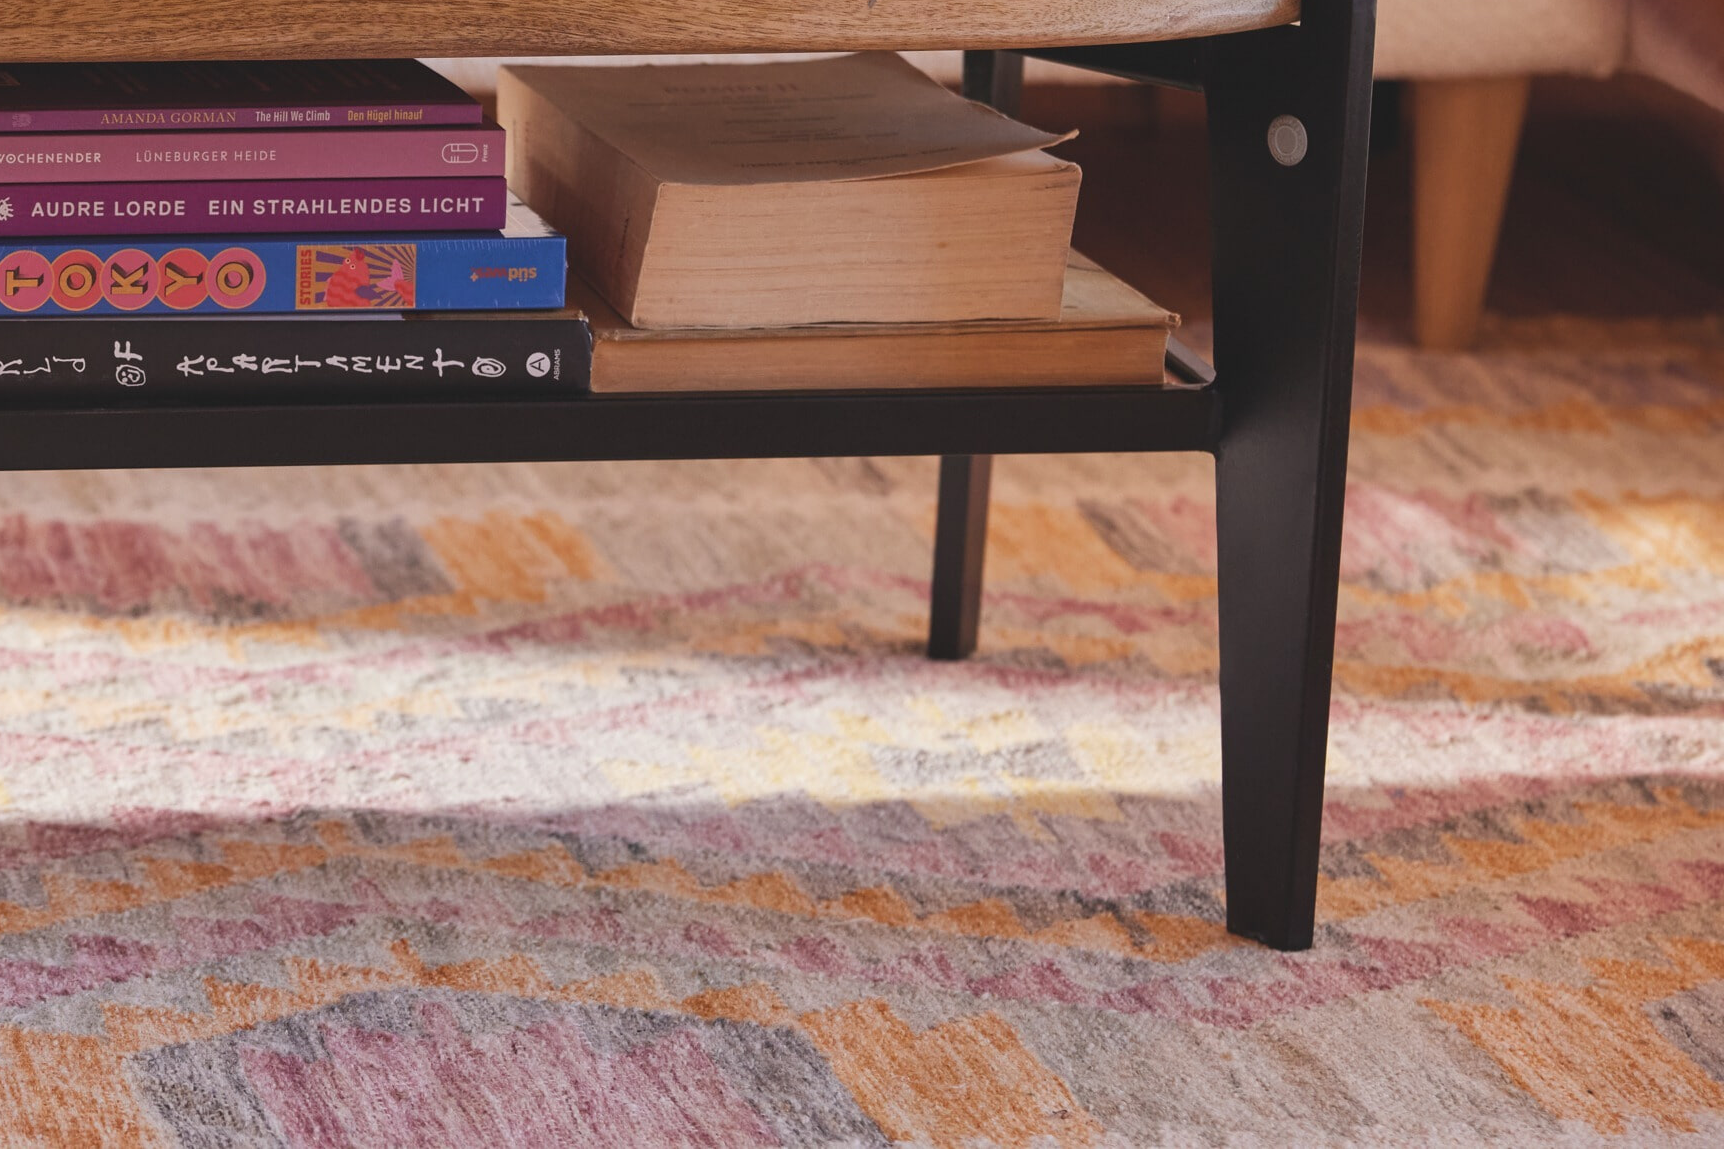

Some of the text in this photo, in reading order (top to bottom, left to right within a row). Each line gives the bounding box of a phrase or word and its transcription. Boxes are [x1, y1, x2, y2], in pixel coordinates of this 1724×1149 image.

[100, 108, 423, 125] AMANDA GORMAN The Hill We Climb Den Hügel hinauf
[136, 150, 228, 162] LÜNEBURGER
[234, 150, 277, 162] HEIDE
[31, 197, 484, 217] AUDRE LORDE EIN STRAHLENDES LICHT
[5, 260, 254, 298] TOKYO
[300, 250, 313, 306] STORIES
[553, 348, 561, 380] ABRAMS
